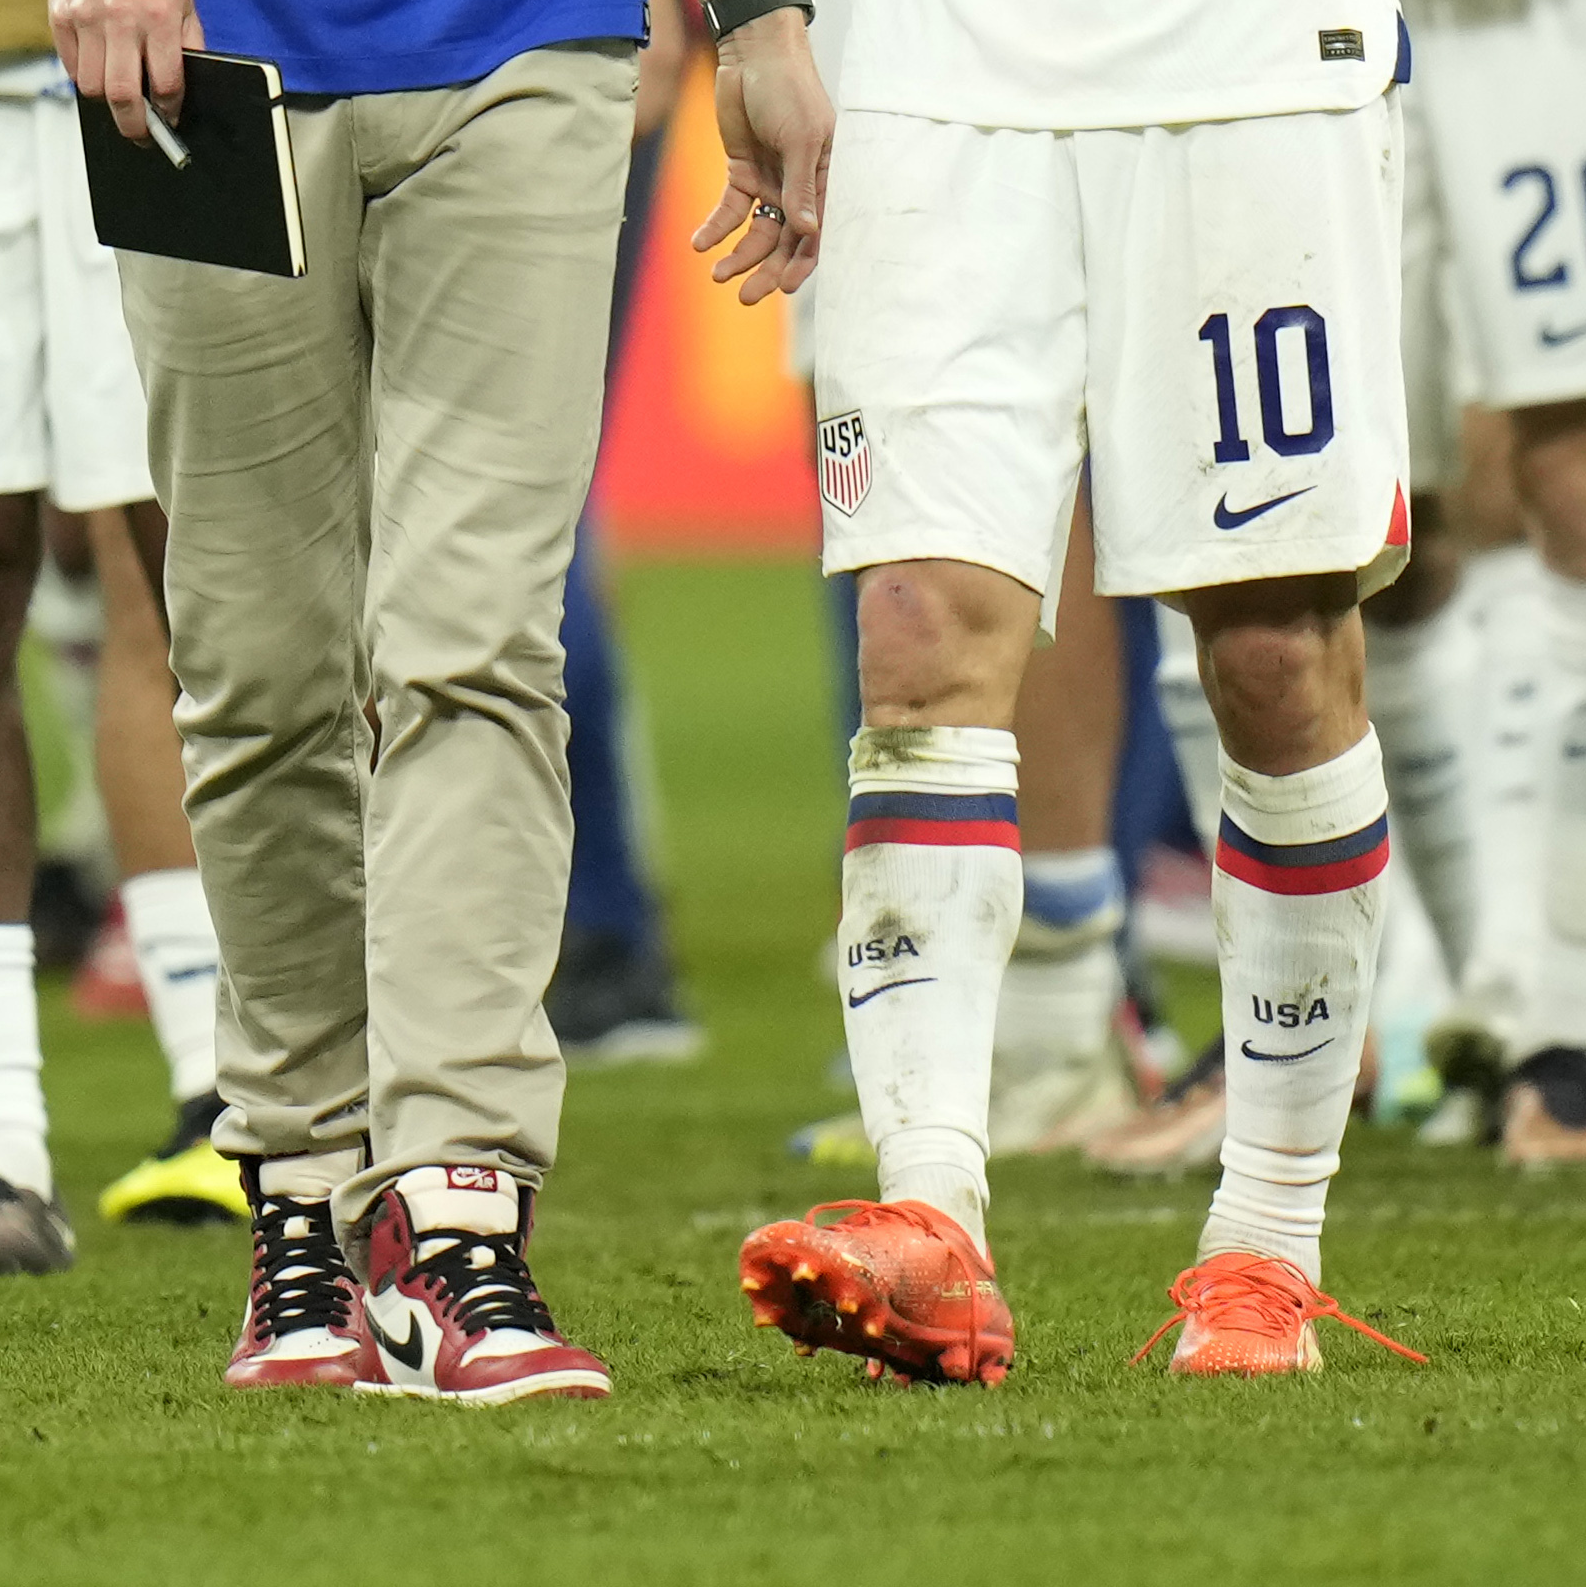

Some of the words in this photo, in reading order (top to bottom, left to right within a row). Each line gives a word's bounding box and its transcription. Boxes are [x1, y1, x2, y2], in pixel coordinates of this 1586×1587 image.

[1198, 304, 1334, 463] 10
[823, 416, 864, 458] USA
[848, 935, 919, 967] USA
[1251, 994, 1330, 1028] USA
